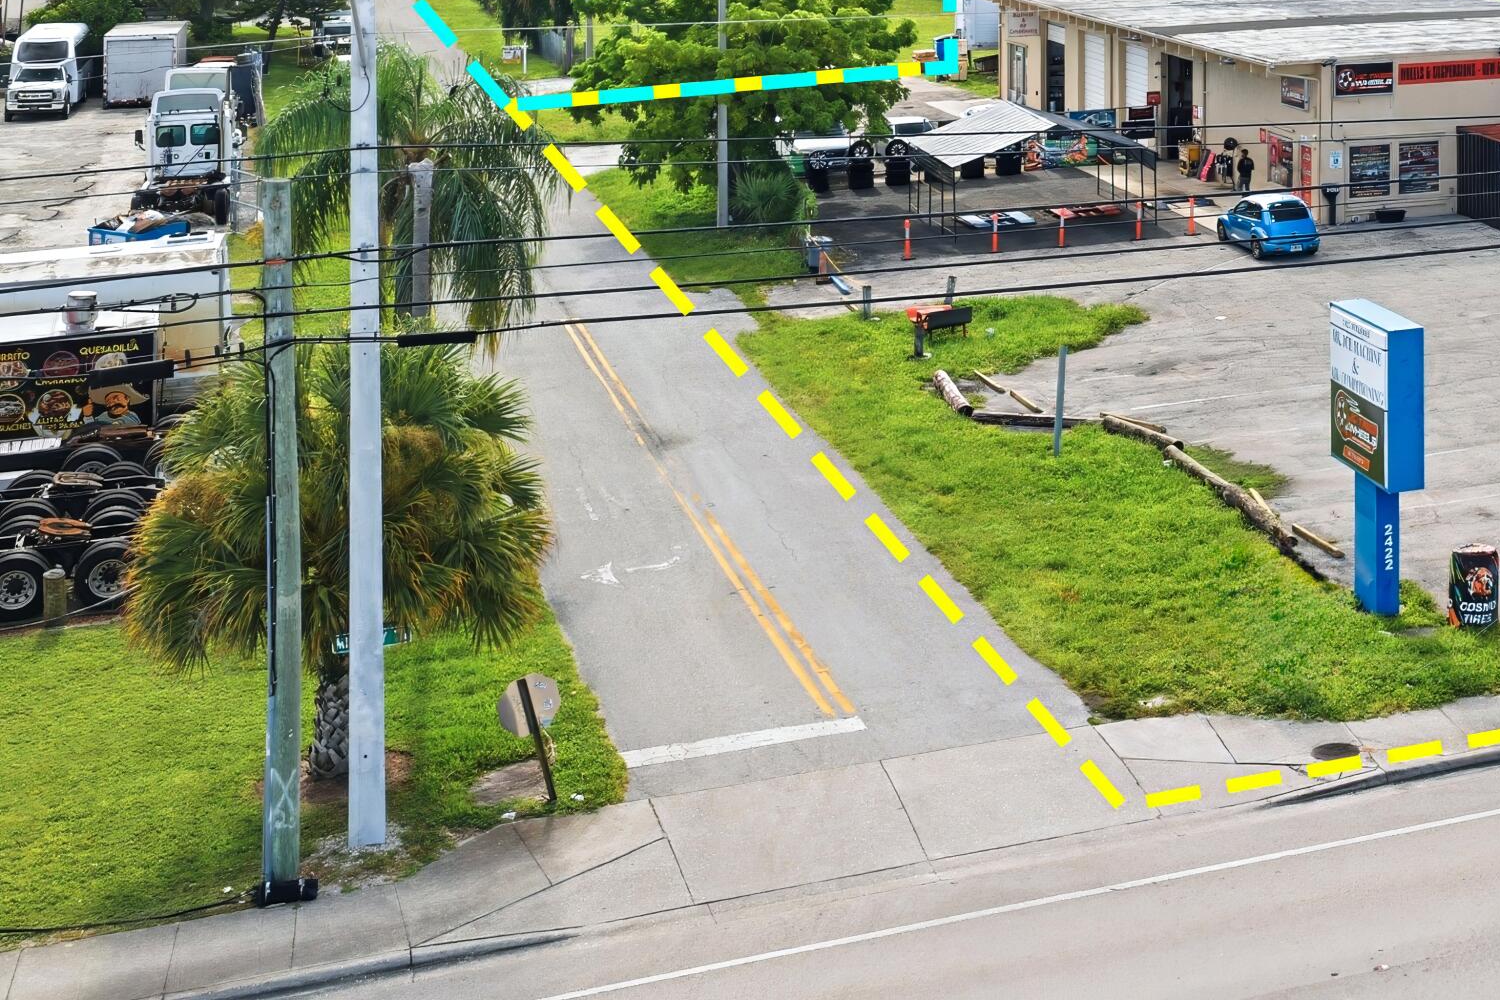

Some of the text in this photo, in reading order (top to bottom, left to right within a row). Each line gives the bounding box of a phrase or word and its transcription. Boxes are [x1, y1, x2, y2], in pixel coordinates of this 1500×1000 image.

[79, 342, 139, 355] QUESADILLA
[1352, 357, 1360, 376] &
[1384, 523, 1394, 571] 2422
